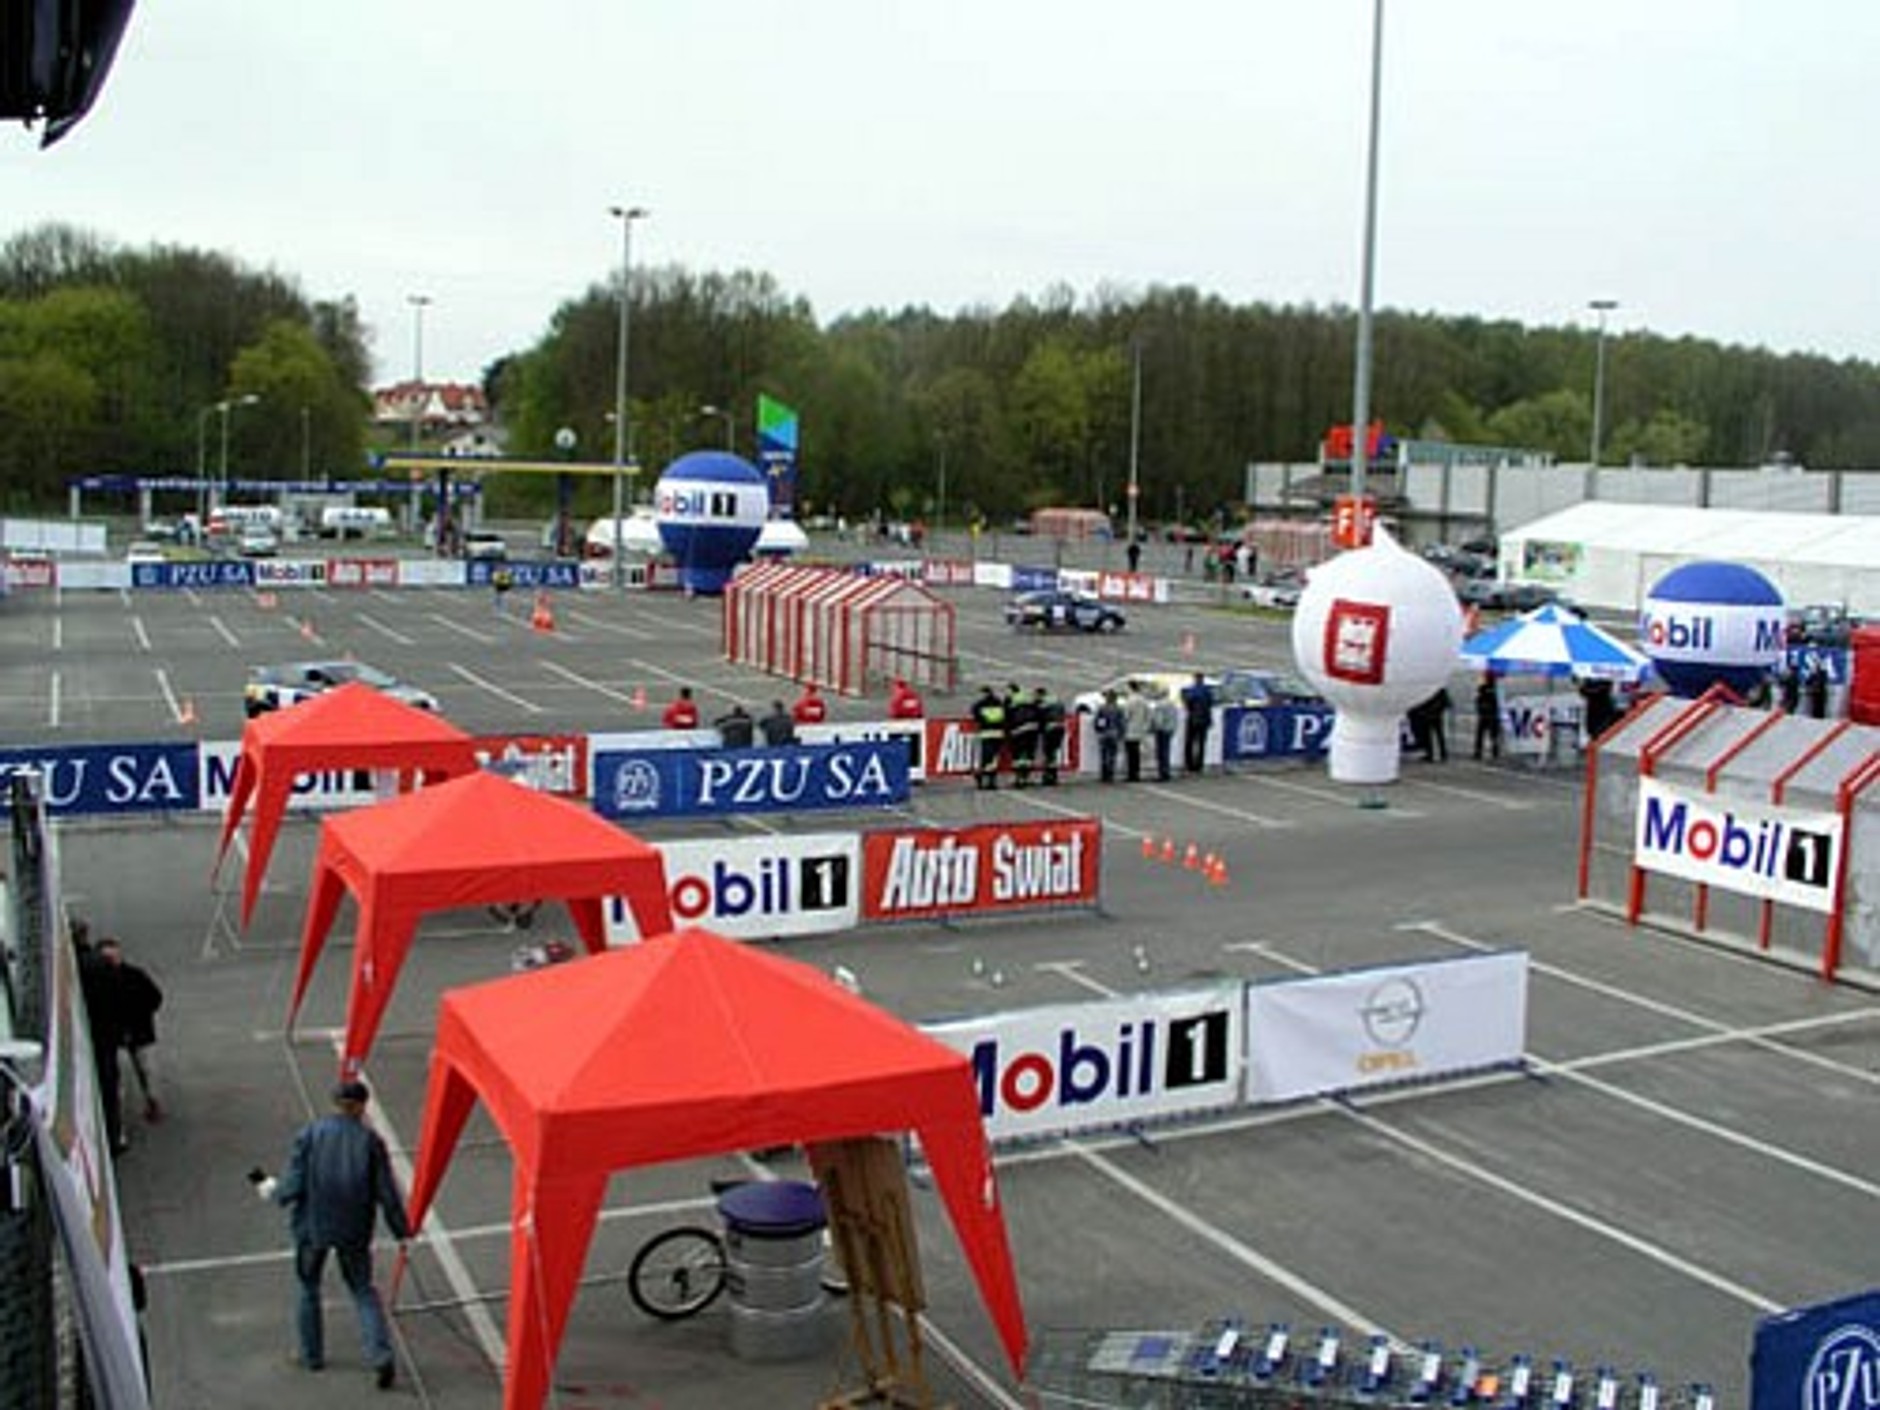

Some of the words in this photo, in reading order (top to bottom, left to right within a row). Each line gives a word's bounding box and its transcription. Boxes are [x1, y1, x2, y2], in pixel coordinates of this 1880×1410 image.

[222, 562, 248, 583] SA
[105, 756, 182, 803] SA
[699, 757, 811, 804] PZU
[824, 751, 892, 799] SA
[1643, 797, 1782, 878] Mobil
[879, 835, 979, 911] Auto
